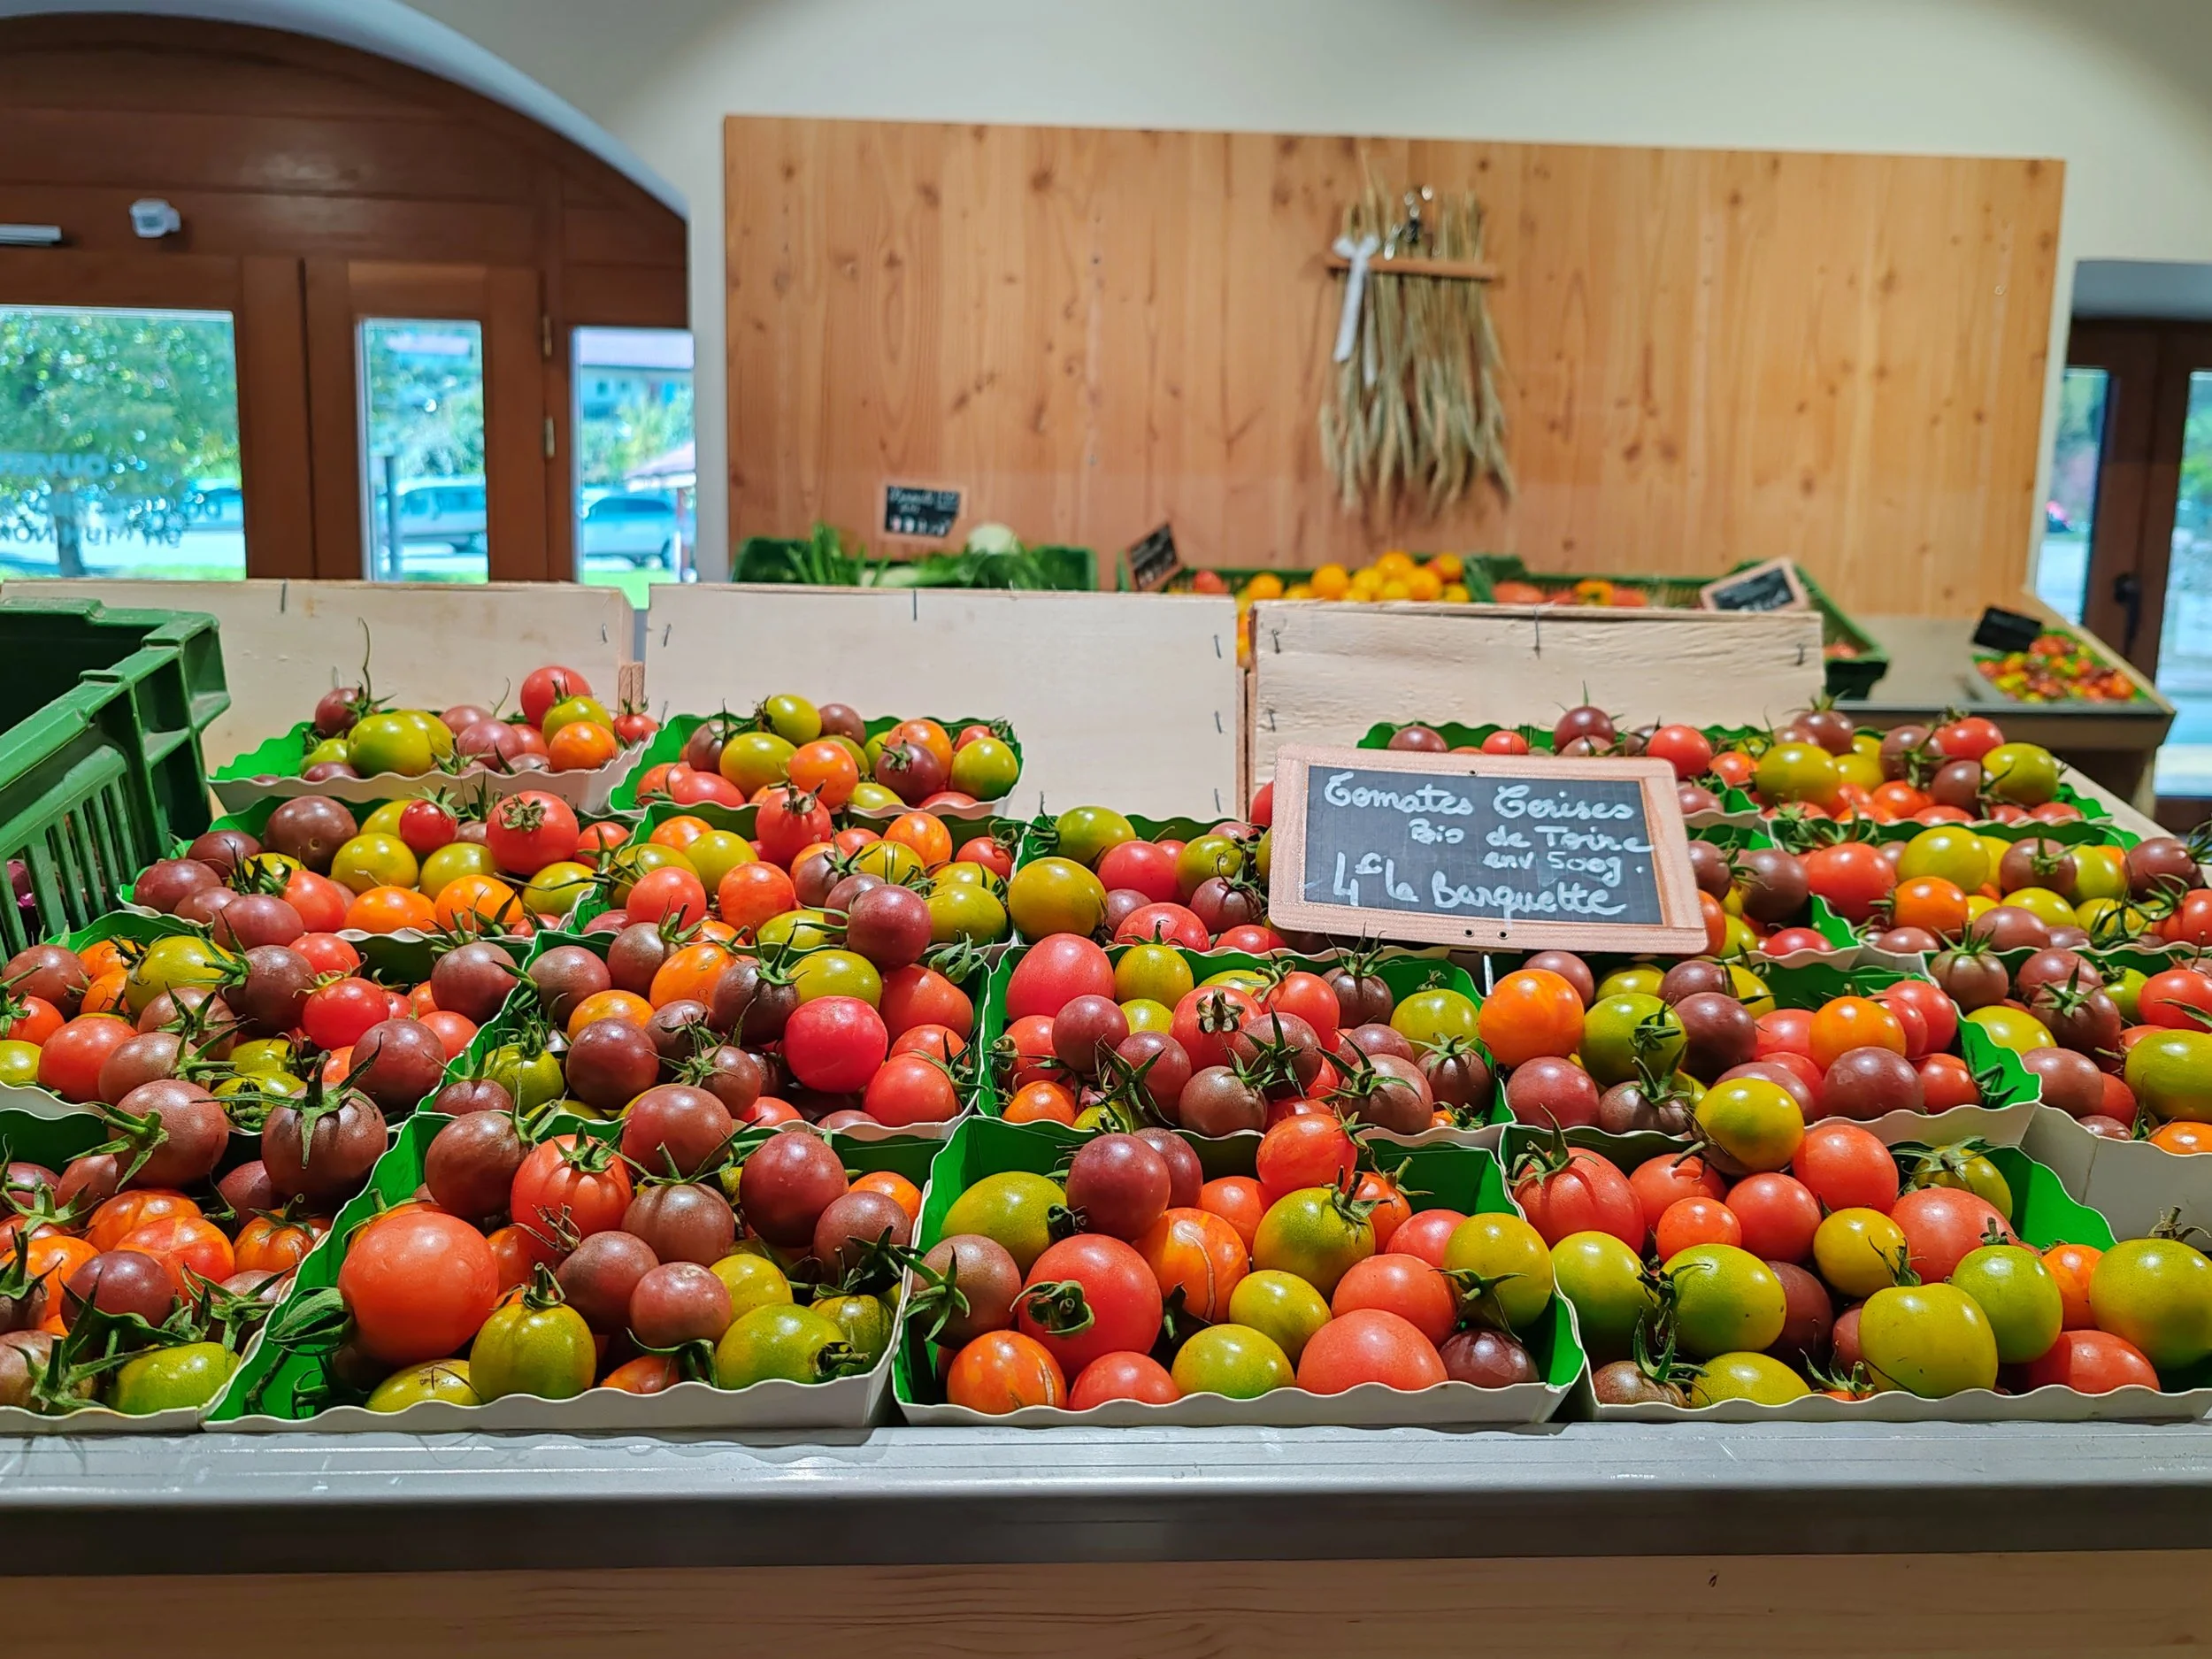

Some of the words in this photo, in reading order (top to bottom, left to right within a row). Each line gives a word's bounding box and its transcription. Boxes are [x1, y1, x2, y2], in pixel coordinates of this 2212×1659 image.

[1325, 771, 1474, 816] Tomates
[1493, 784, 1635, 820] Cerises
[1409, 818, 1465, 845] Bio
[1486, 824, 1532, 849] de
[1482, 850, 1536, 871] env
[1385, 858, 1420, 902] la
